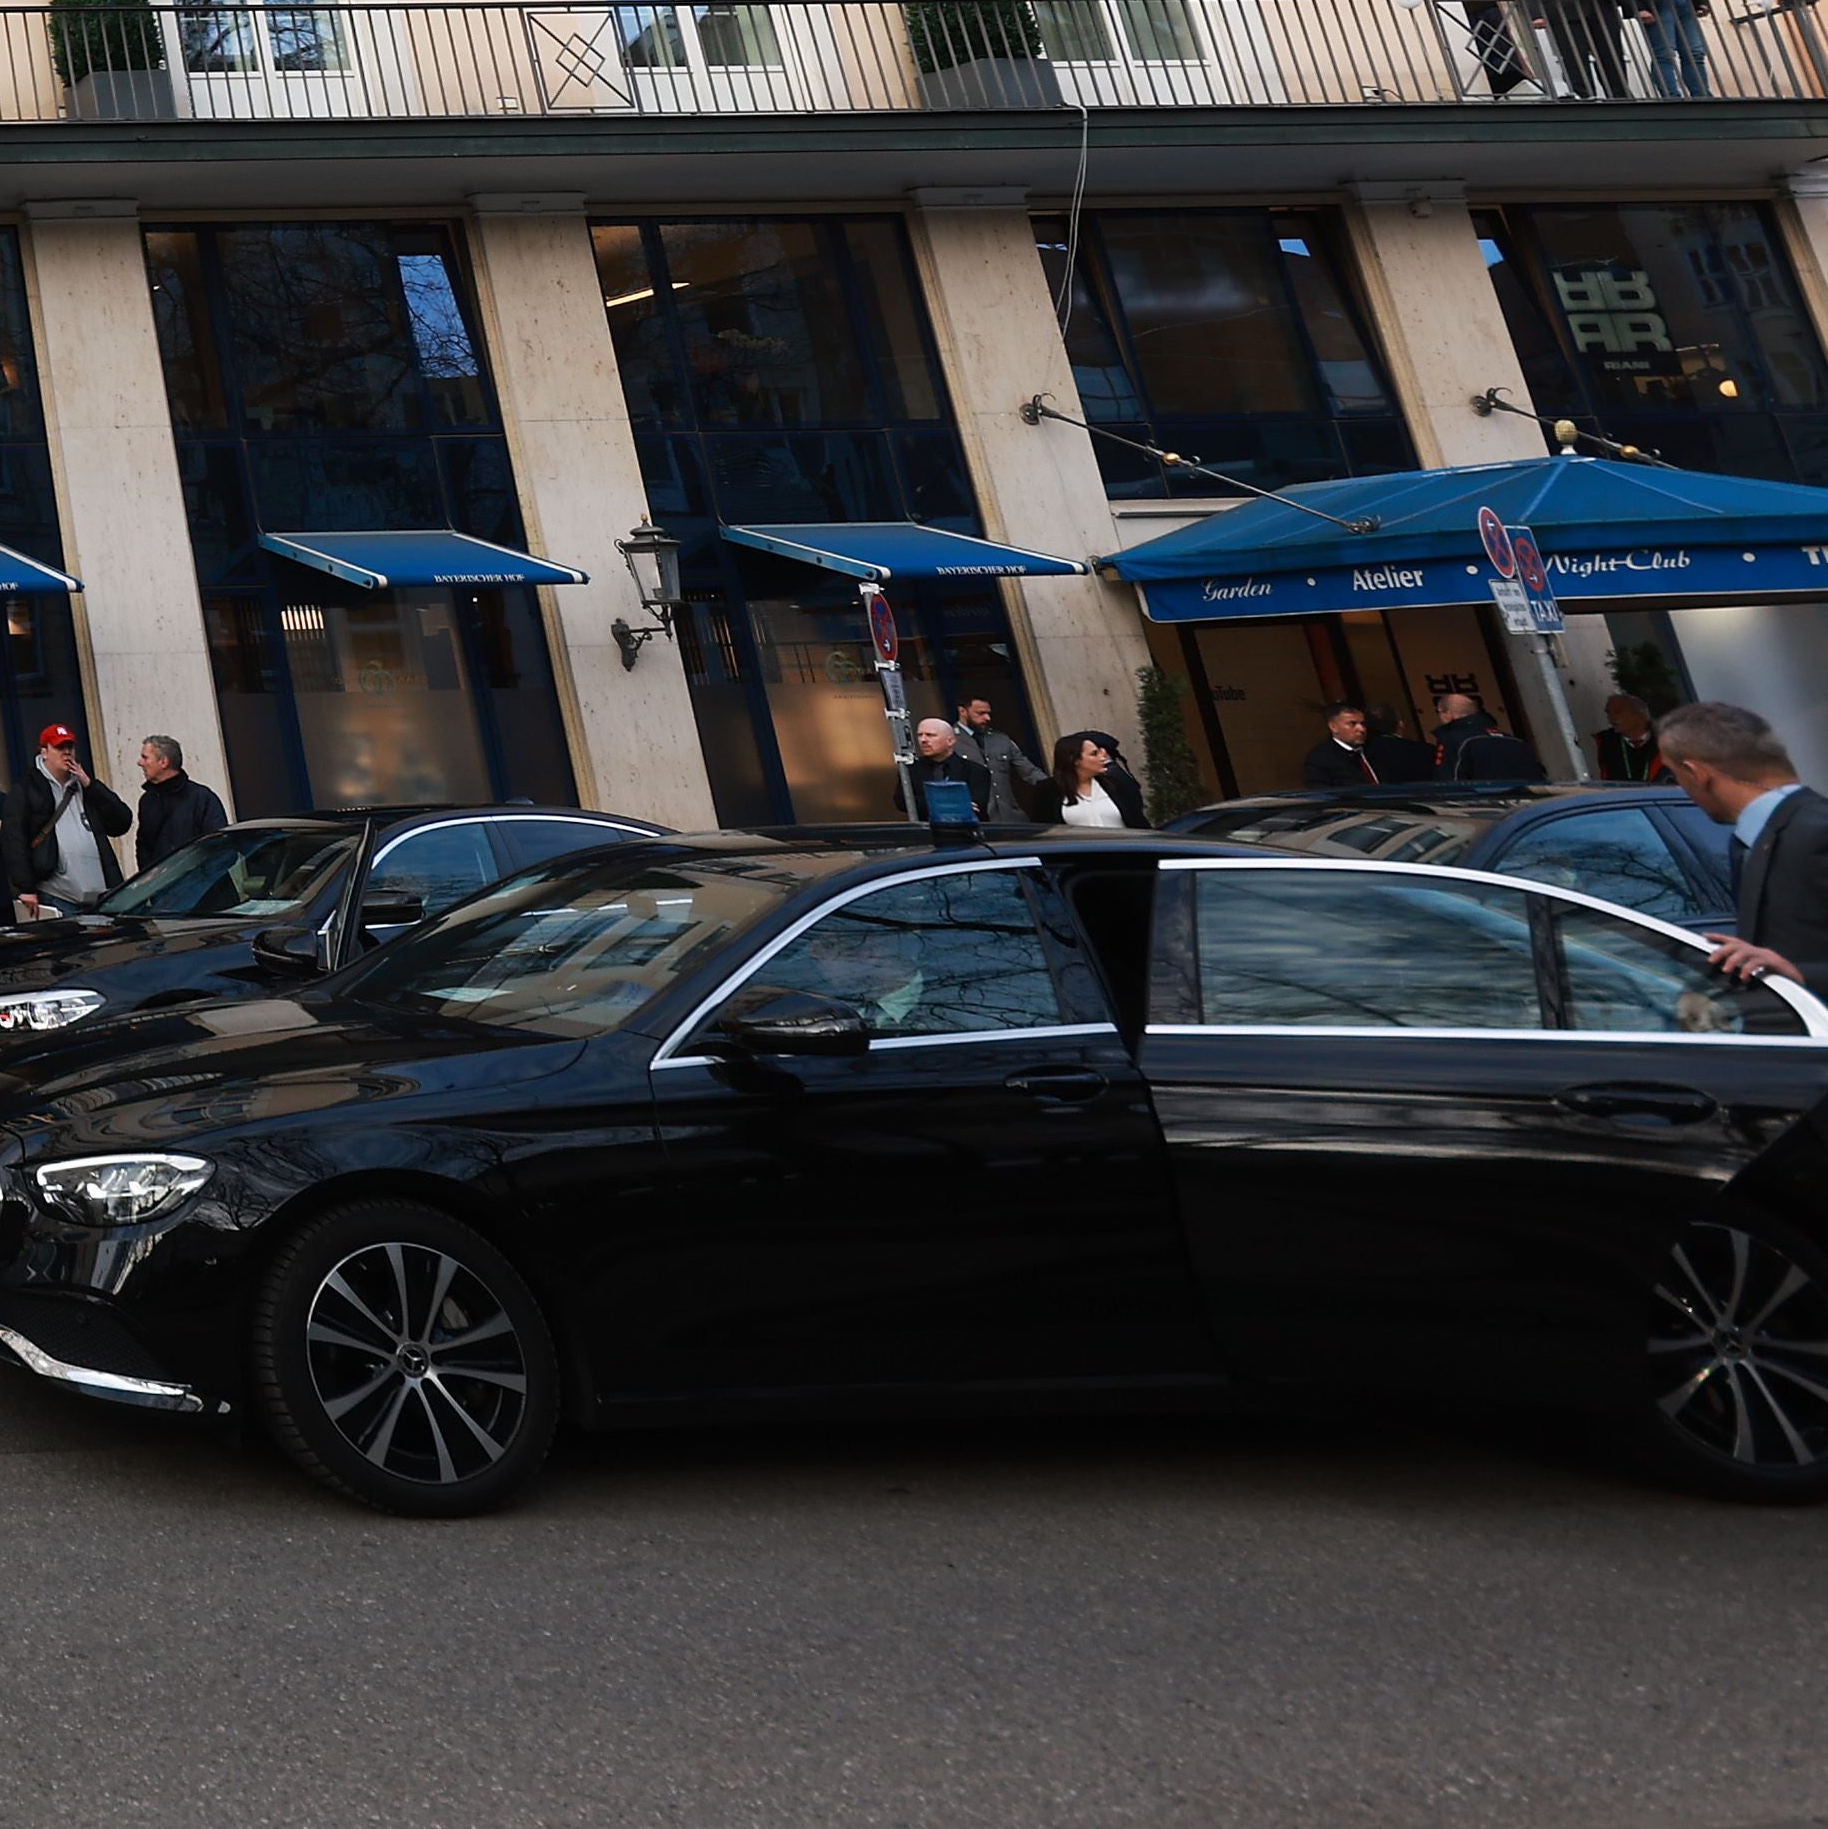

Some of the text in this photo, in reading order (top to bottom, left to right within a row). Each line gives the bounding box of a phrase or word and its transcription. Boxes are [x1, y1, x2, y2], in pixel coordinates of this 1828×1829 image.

[433, 573, 525, 583] BAYERISCHER HOF
[936, 565, 1027, 576] BAYERISCHER HOF
[1352, 564, 1424, 591] Atelier
[1201, 578, 1273, 602] Garden
[1530, 600, 1561, 623] TAXI
